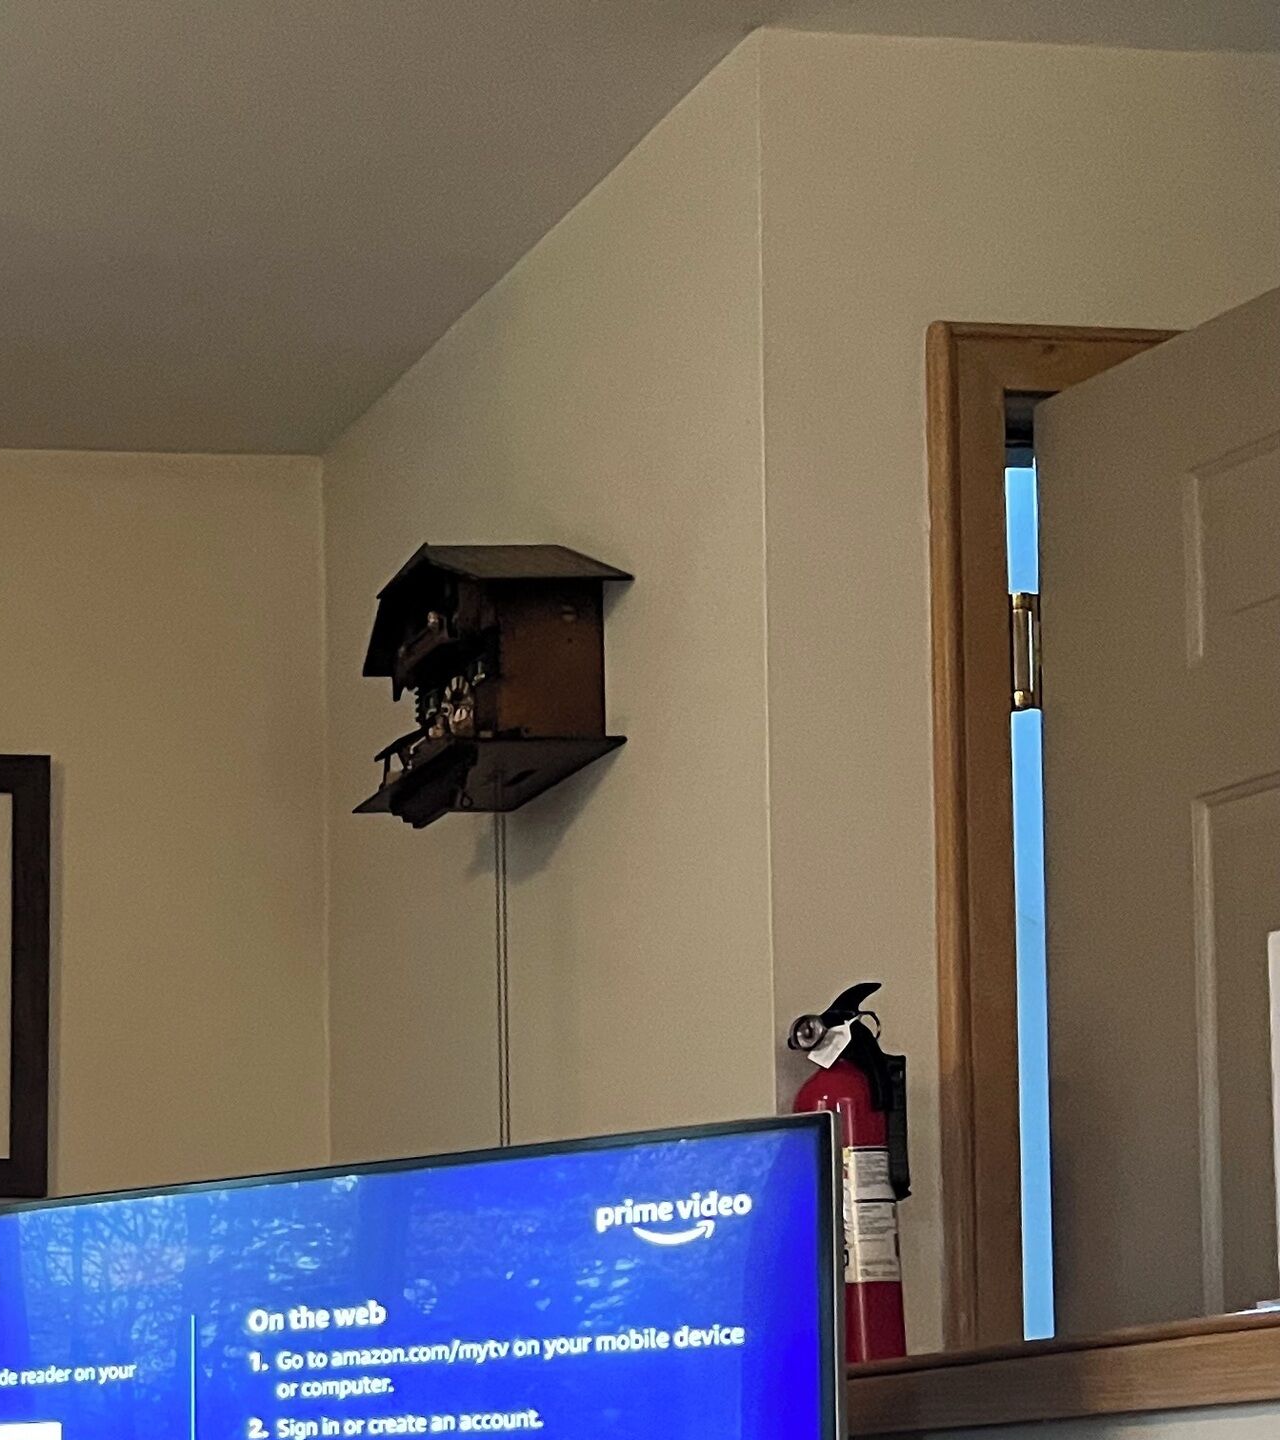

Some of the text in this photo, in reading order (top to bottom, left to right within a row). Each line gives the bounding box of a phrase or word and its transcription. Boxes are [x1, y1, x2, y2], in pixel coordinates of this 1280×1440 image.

[596, 1190, 753, 1233] prime video
[248, 1299, 387, 1332] On the web
[248, 1324, 745, 1372] 1. Go to amazon.com/mytv on your mobile device
[21, 1365, 72, 1385] reader
[74, 1366, 96, 1382] on
[98, 1364, 137, 1385] your
[276, 1376, 395, 1400] or computer.
[248, 1417, 269, 1440] 2.
[321, 1416, 340, 1435] in
[343, 1418, 365, 1435] or
[367, 1415, 427, 1434] create
[430, 1415, 455, 1432] an
[459, 1408, 544, 1431] account.
